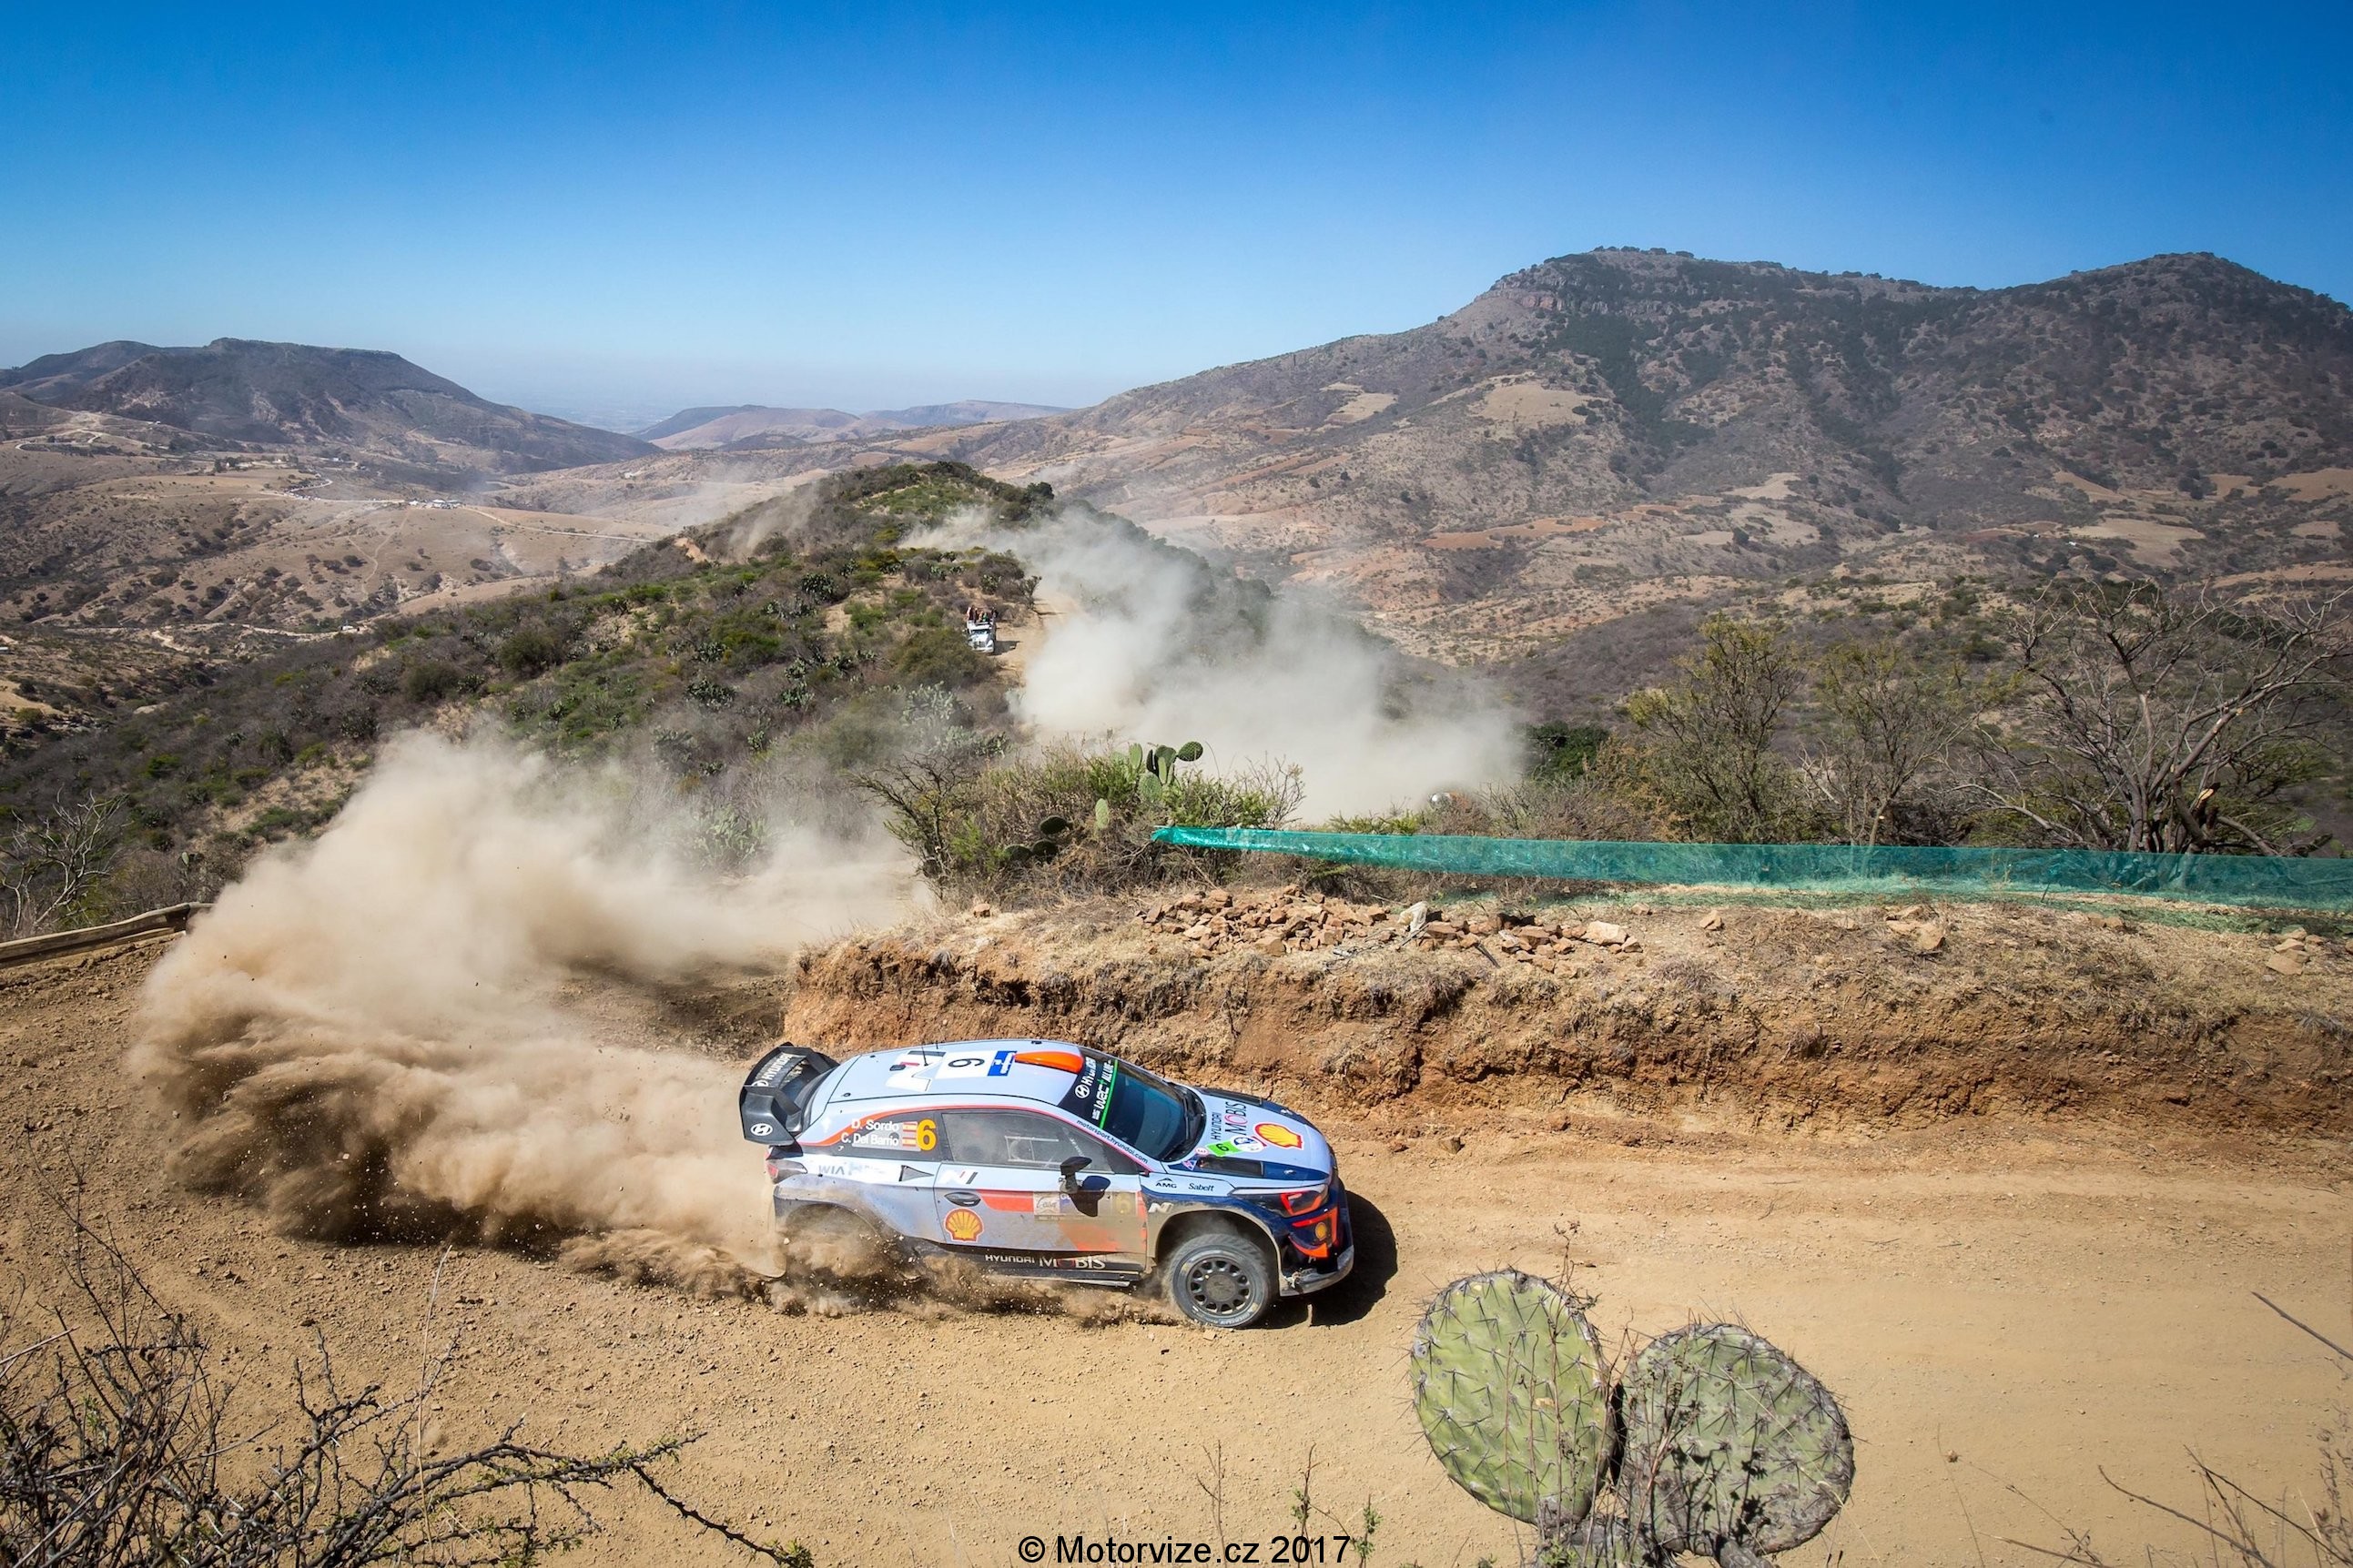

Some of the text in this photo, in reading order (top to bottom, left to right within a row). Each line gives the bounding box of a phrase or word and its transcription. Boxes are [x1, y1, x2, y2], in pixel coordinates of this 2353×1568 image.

[851, 1118, 900, 1132] D. Sordo
[1211, 1112, 1222, 1141] HYUNDAI
[1224, 1101, 1248, 1136] MOBIS
[841, 1132, 899, 1147] C. Del Barrio
[917, 1118, 938, 1152] 6
[1076, 1118, 1149, 1164] motorsport.hyundai.com
[1216, 1143, 1230, 1152] 6
[1188, 1183, 1214, 1192] Sabelt
[985, 1254, 1106, 1270] HYUNDAI MOBIS
